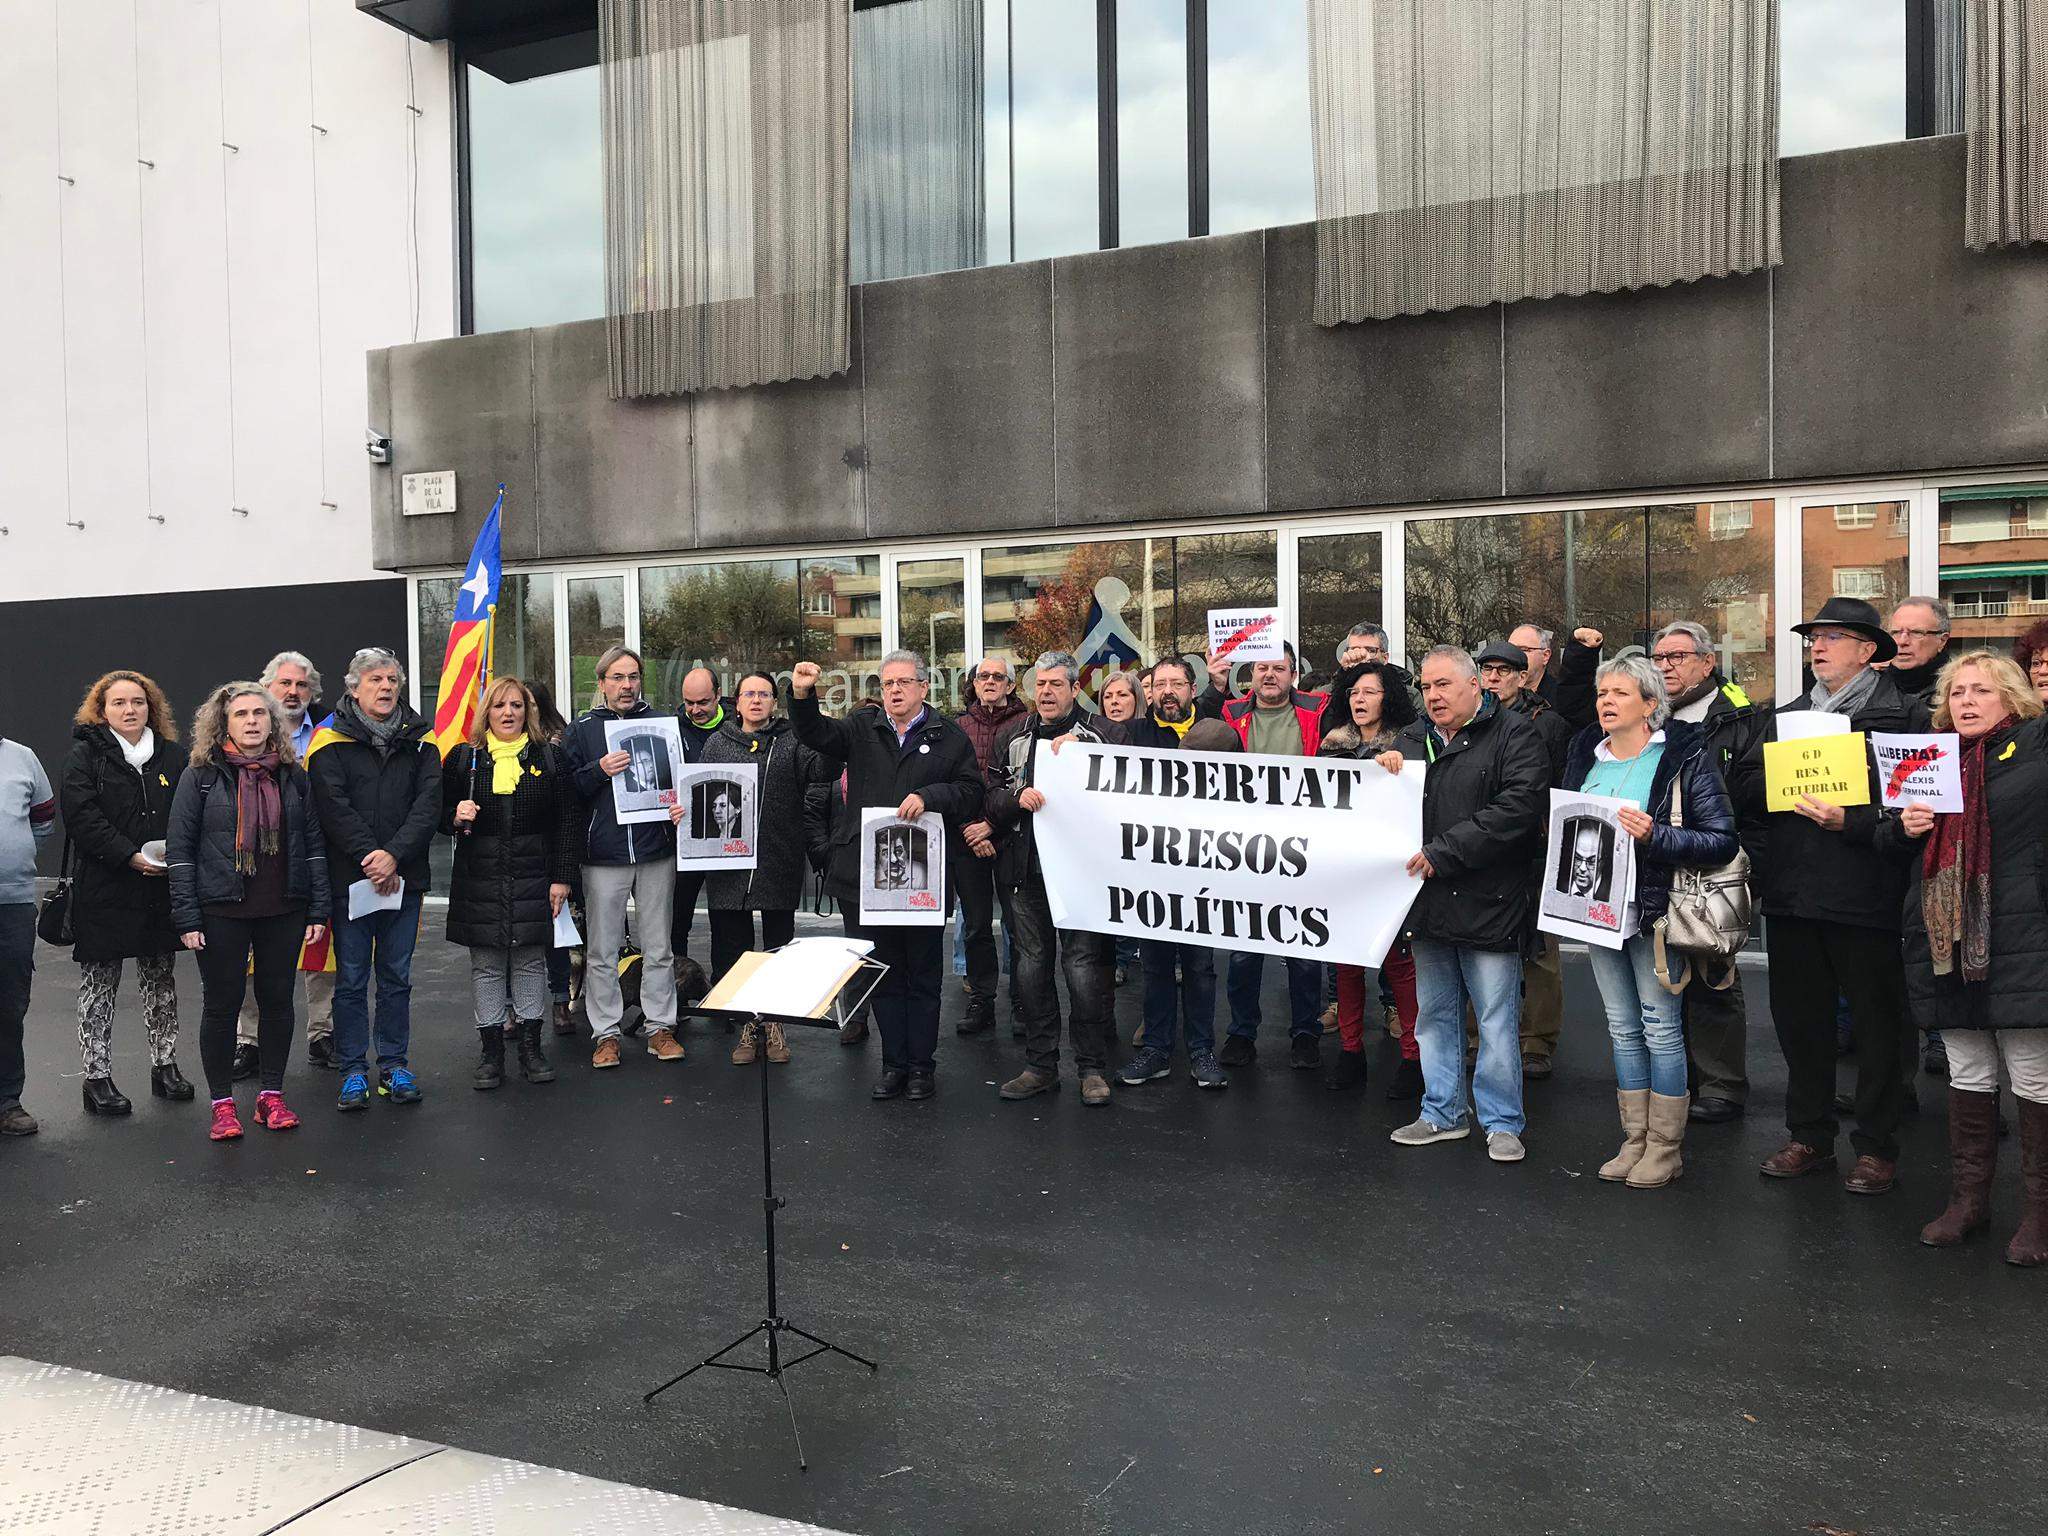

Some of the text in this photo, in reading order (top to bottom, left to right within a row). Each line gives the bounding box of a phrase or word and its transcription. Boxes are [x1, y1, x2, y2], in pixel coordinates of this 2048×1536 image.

[424, 477, 442, 485] PLAÇA
[424, 487, 442, 496] DE LA
[426, 498, 442, 508] VILA
[1215, 617, 1272, 628] LLIBERTAT
[1802, 749, 1821, 760] 6 D
[1878, 745, 1940, 760] LLIBERTAT
[1795, 766, 1831, 778] RES A
[1915, 764, 1939, 772] XAVI
[1085, 754, 1361, 810] LLIBERTAT
[1904, 776, 1935, 784] ALEXIS
[1782, 781, 1848, 796] CELEBRAR
[1120, 822, 1309, 878] PRESOS
[1107, 886, 1330, 947] POLÍTICS
